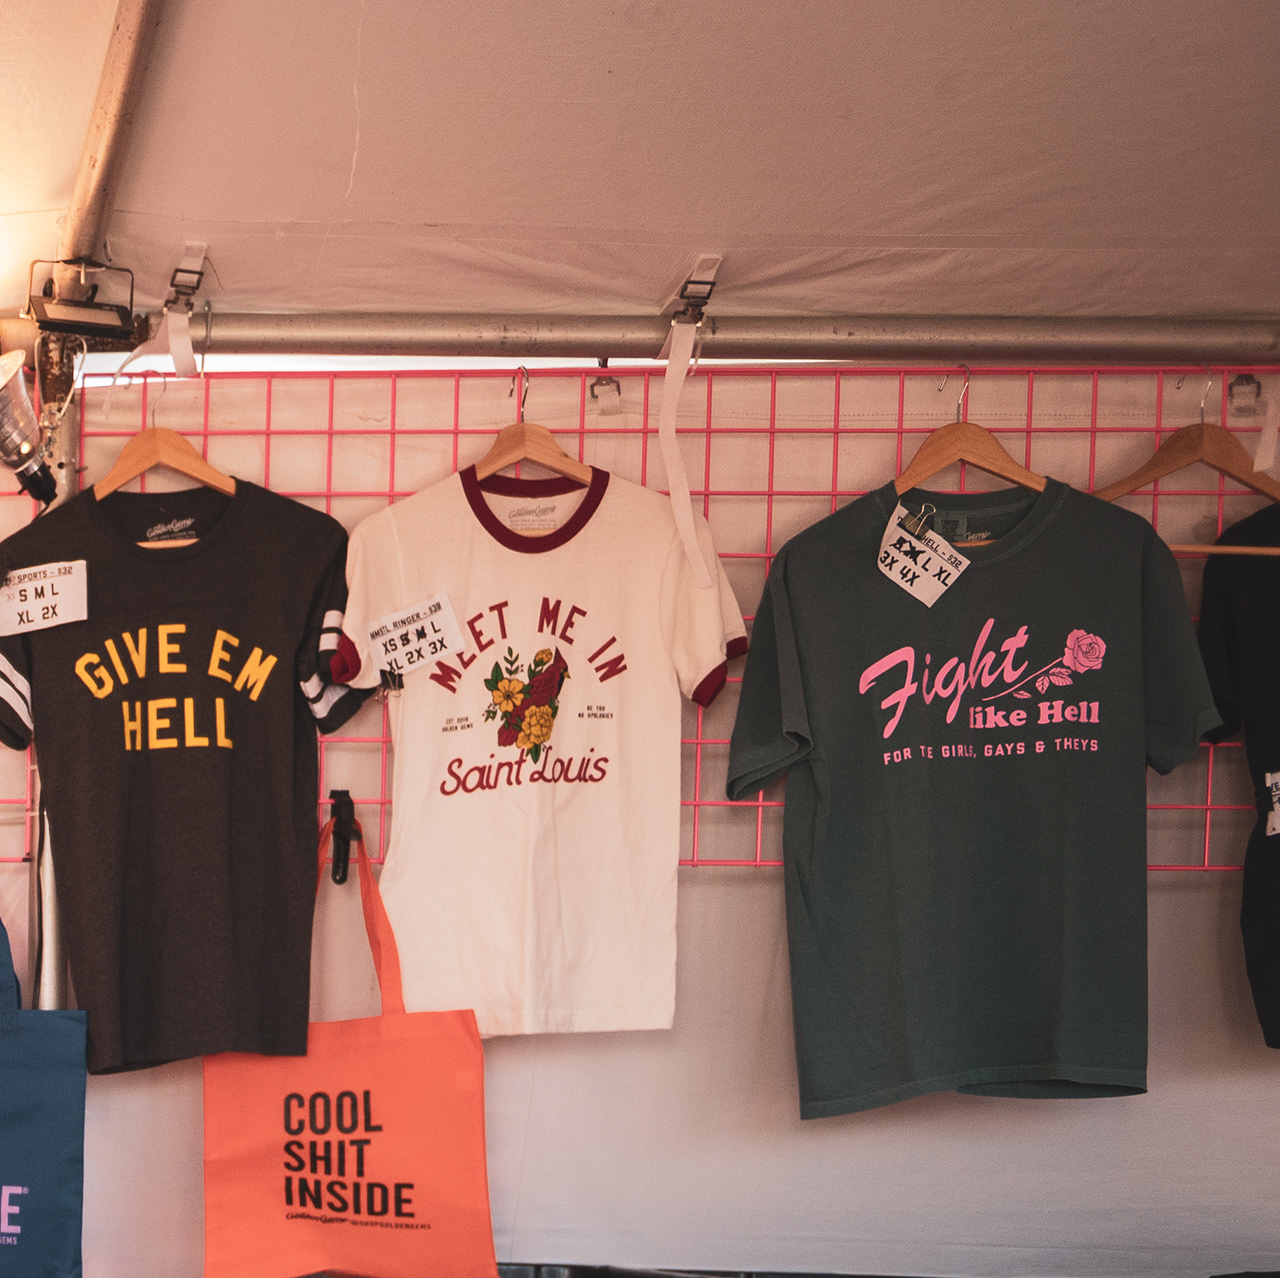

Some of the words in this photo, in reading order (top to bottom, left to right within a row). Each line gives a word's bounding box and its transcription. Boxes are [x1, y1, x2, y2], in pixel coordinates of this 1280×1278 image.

[921, 535, 940, 552] HELL
[17, 570, 47, 583] SPORTS
[880, 550, 899, 571] 3X
[899, 565, 920, 587] 4X
[932, 566, 951, 587] XL
[17, 611, 34, 625] XL
[42, 604, 58, 620] 2X
[392, 612, 421, 631] RINGER
[381, 638, 398, 655] XS
[406, 646, 425, 665] 2X
[428, 637, 448, 654] 3X
[429, 600, 509, 695] MEET
[537, 597, 588, 646] ME
[587, 635, 628, 683] IN
[74, 624, 187, 699] GIVE
[207, 629, 278, 701] EM
[859, 617, 1029, 739] Fight
[122, 698, 233, 751] HELL
[969, 705, 1027, 729] like
[1037, 700, 1100, 725] Hell
[883, 747, 912, 766] FOR
[941, 744, 976, 758] GIRLS,
[984, 742, 1025, 757] GAYS
[1035, 741, 1046, 753] &
[1054, 737, 1098, 752] THEYS
[439, 748, 525, 796] Saint
[528, 745, 609, 786] Louis
[283, 1090, 384, 1136] COOL
[283, 1138, 372, 1178] SHIT
[283, 1176, 416, 1219] INSIDE
[350, 1219, 432, 1231] @SHOPGOLDENGEMS
